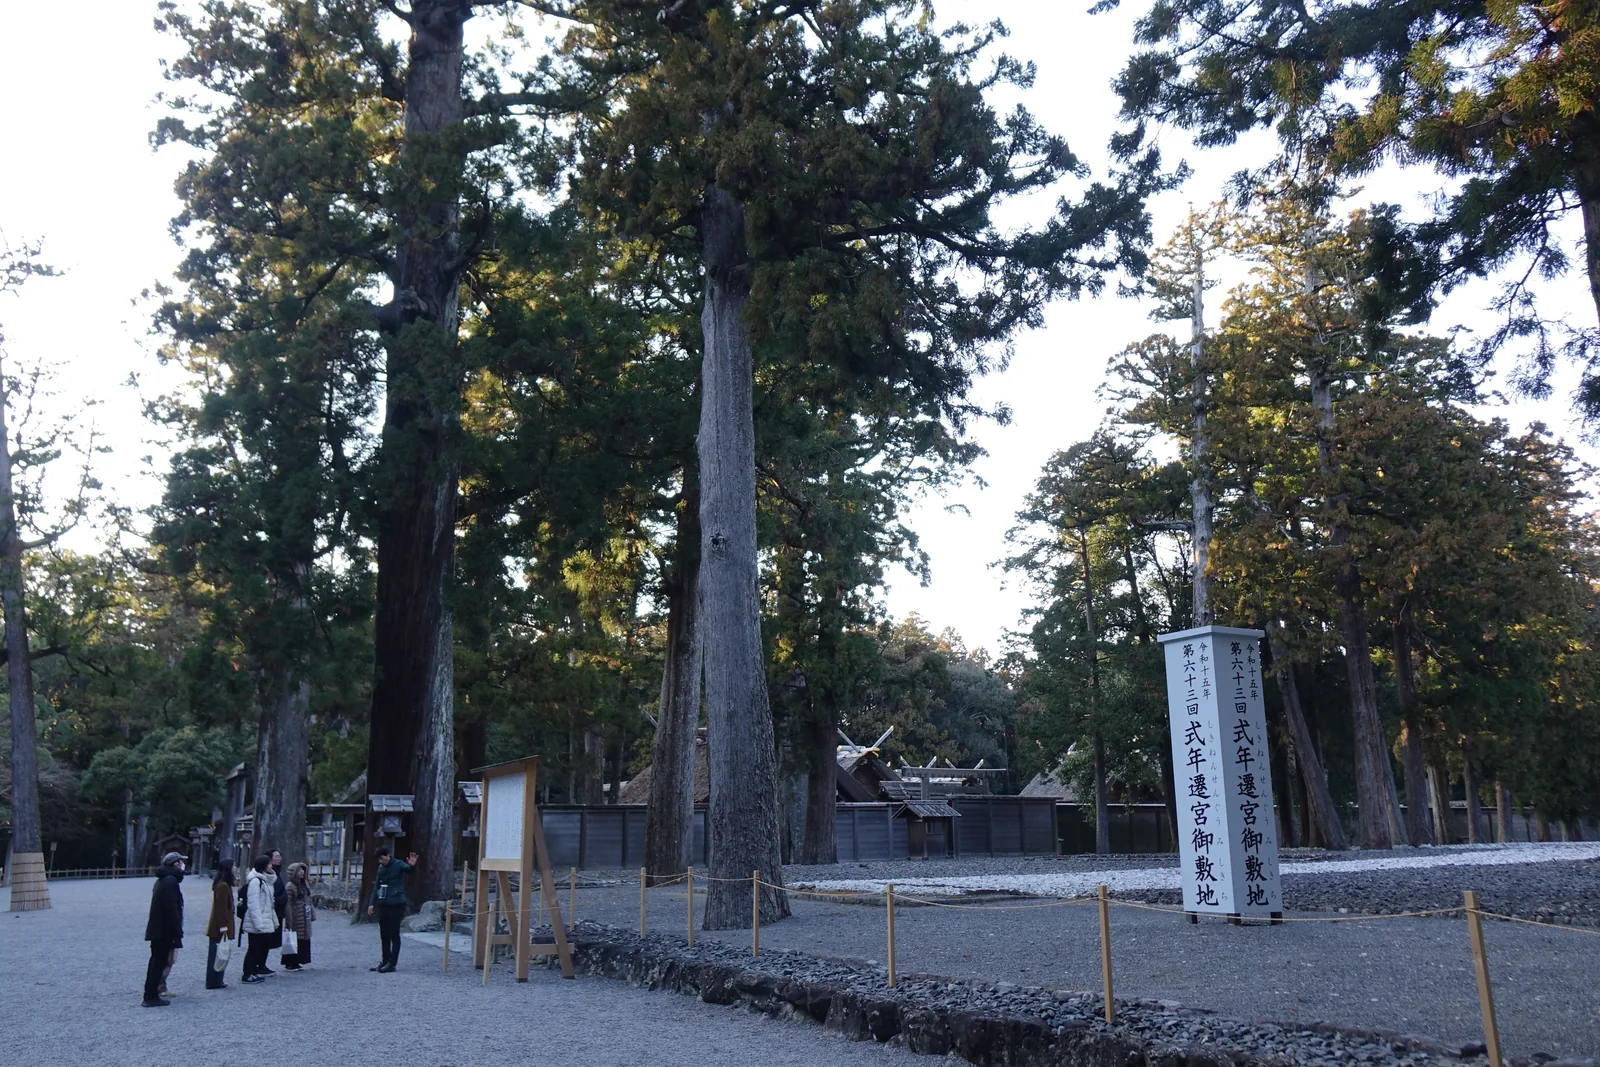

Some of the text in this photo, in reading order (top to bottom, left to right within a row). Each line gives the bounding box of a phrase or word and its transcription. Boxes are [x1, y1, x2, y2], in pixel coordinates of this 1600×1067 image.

[1199, 642, 1211, 700] 令和十五年
[1246, 643, 1258, 701] 令和十五年
